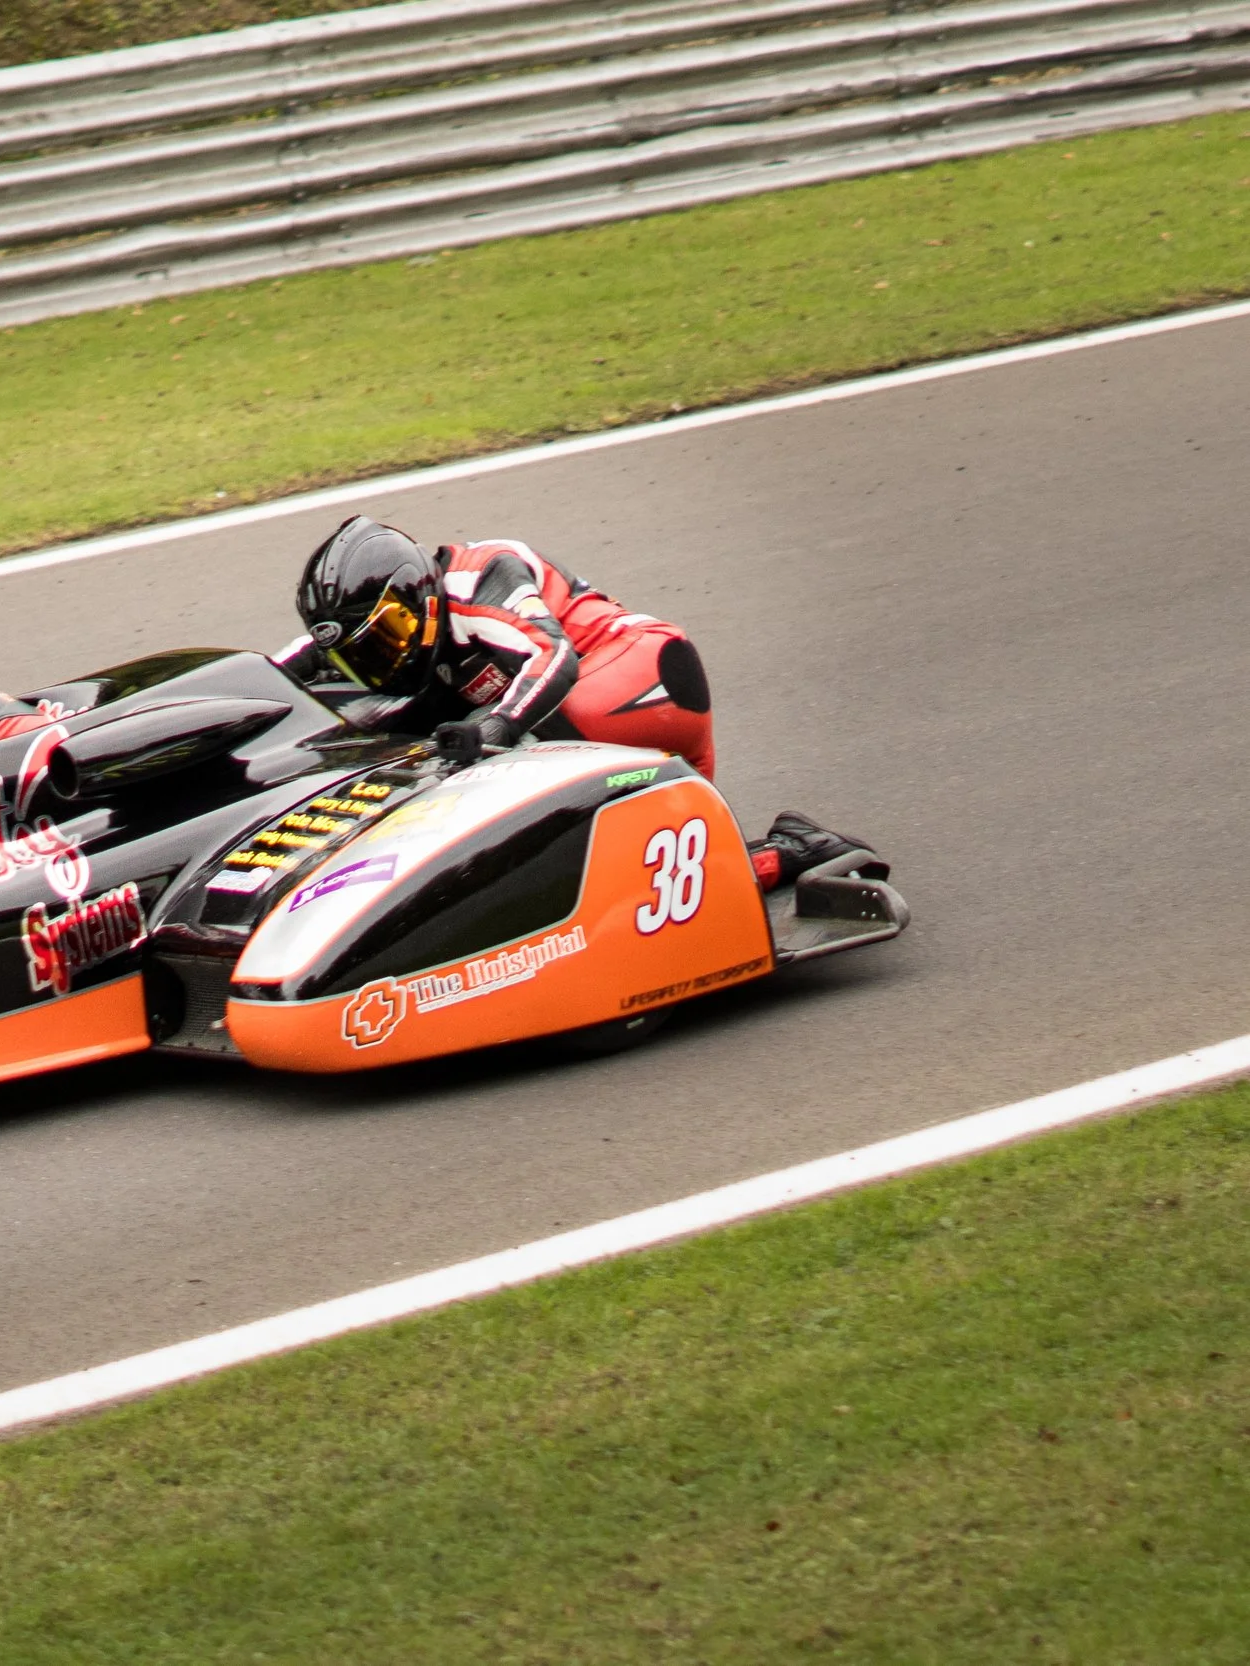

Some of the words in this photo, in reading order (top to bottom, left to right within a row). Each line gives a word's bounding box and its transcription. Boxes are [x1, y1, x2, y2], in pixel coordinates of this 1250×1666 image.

[350, 782, 391, 799] Leo
[605, 766, 659, 788] KIRSTY
[635, 817, 707, 936] 38
[22, 882, 148, 993] Systems
[408, 972, 463, 1004] The
[464, 925, 587, 988] Hoistpital
[620, 980, 691, 1010] LIFESAFETY
